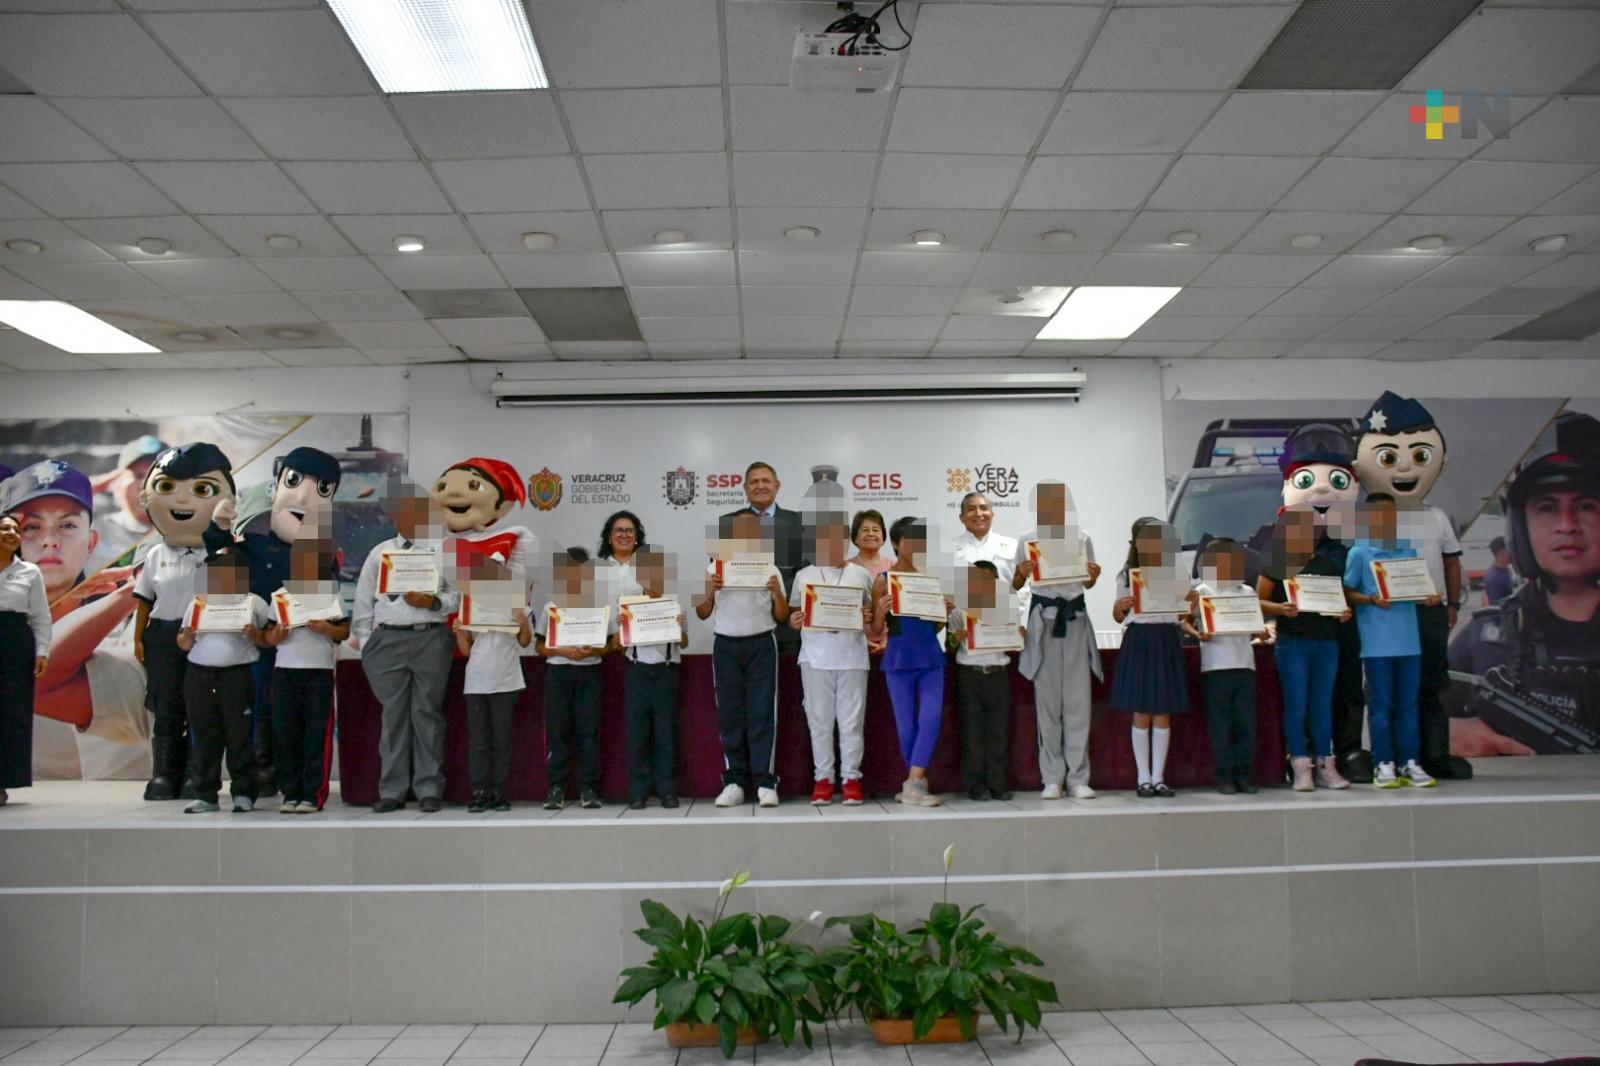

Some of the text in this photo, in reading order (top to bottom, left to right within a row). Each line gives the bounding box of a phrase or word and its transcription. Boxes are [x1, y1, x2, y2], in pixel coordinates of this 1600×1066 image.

[974, 463, 1019, 480] VERA
[571, 474, 626, 483] VERACRUZ
[706, 474, 743, 488] SSP
[851, 473, 902, 490] CEIS
[571, 484, 622, 493] GOBIERNO
[975, 481, 1019, 498] CRUZ
[571, 494, 631, 504] DEL ESTADO
[706, 498, 744, 506] Seguridad
